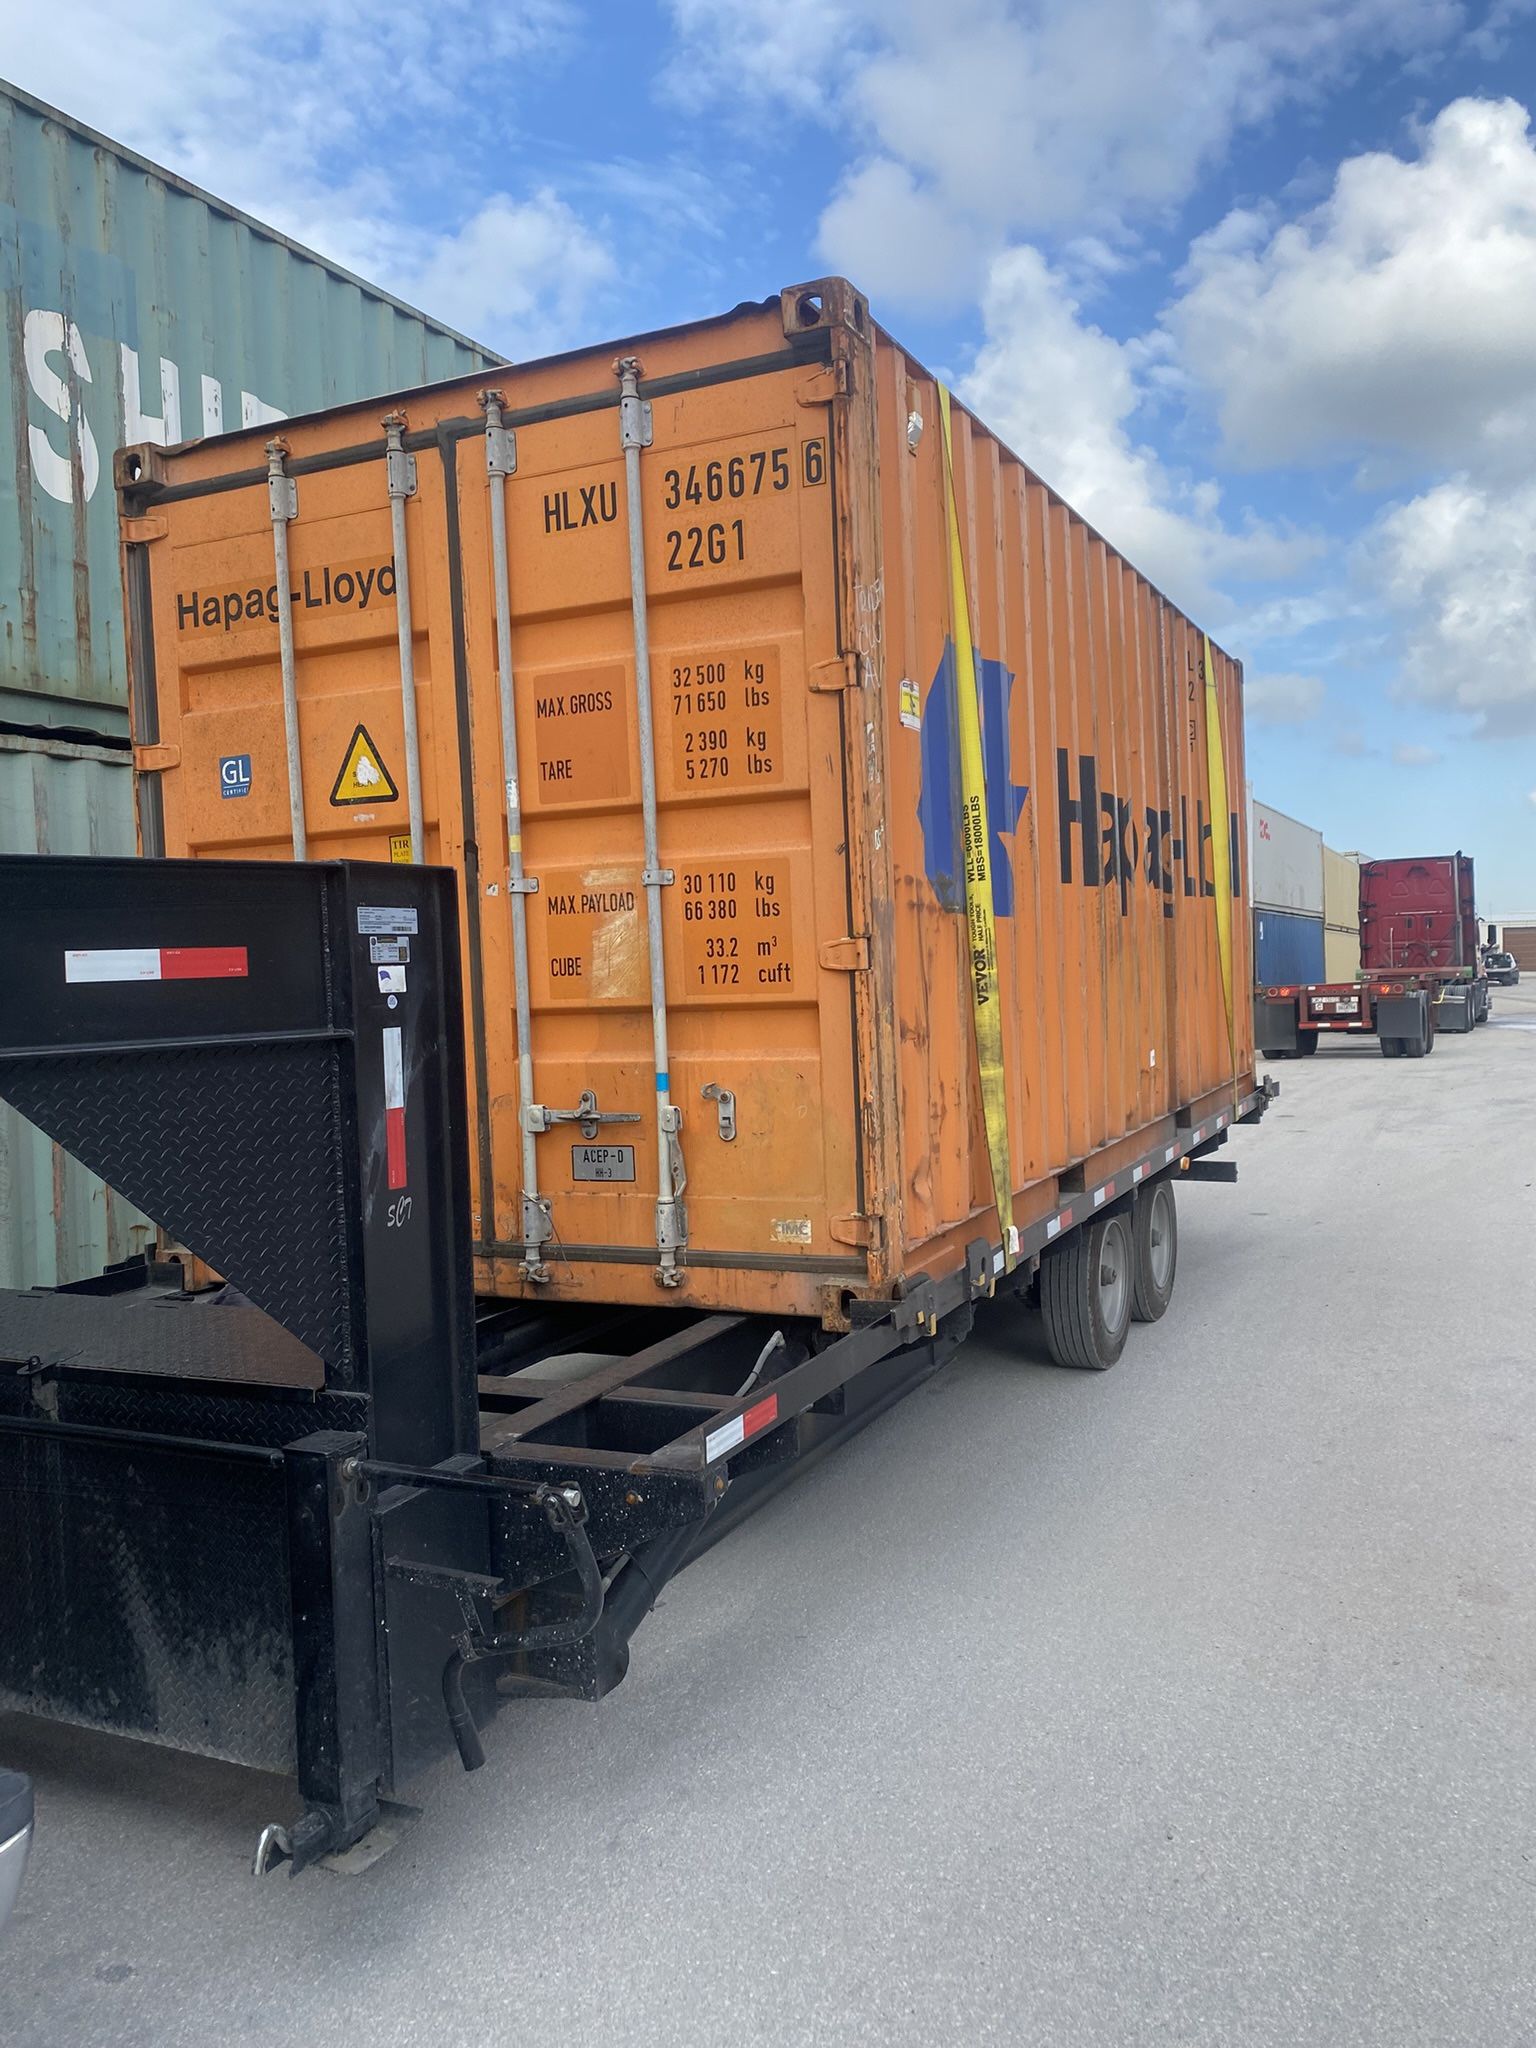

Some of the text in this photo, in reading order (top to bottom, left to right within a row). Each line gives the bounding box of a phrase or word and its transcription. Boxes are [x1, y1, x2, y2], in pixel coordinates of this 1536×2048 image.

[23, 308, 290, 503] SH
[543, 441, 823, 533] HLXU 346675 6
[667, 519, 745, 571] 22G1
[177, 556, 397, 631] Hapag-Lloyd
[744, 660, 764, 684] kg
[745, 687, 770, 708] lbs
[747, 727, 766, 751] kg
[222, 759, 250, 785] GL
[540, 759, 573, 781] TARE
[747, 754, 772, 774] lbs
[222, 787, 250, 797] CERTIFIE
[392, 839, 410, 850] TIR
[1056, 748, 1241, 918] Hapag-Ll
[755, 871, 774, 895] kg
[755, 898, 780, 918] lbs
[706, 937, 738, 958] 33.2
[551, 957, 582, 977] CUBE
[758, 962, 792, 983] cuft
[974, 949, 990, 1006] VEVOR
